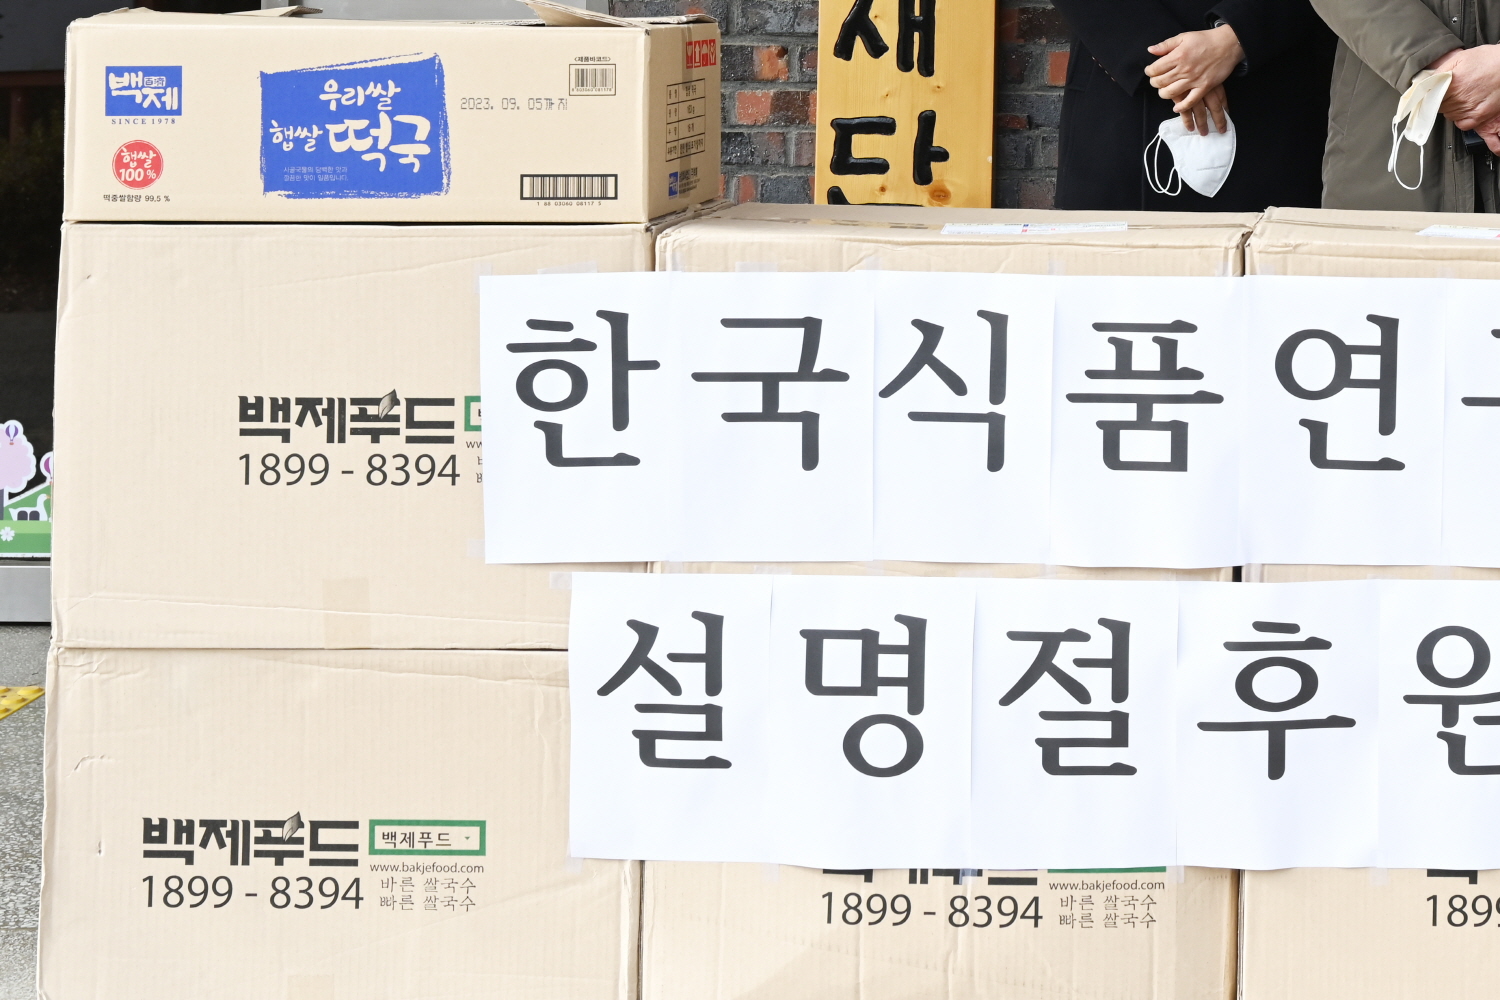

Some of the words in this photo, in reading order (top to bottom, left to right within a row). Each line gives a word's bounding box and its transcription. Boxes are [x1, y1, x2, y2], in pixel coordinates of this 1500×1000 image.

[108, 71, 178, 110] 백제
[319, 79, 401, 111] 우리쌀
[460, 98, 494, 110] 2023.
[502, 98, 520, 110] 09.
[270, 120, 323, 152] 햅쌀
[325, 112, 431, 173] 떡국
[120, 146, 156, 168] 햅쌀
[238, 393, 455, 444] 백제푸드
[239, 452, 330, 486] 1899
[366, 453, 460, 486] 8394
[142, 815, 359, 867] 백제푸드
[382, 830, 452, 849] 백제푸드
[370, 862, 484, 876] www.bakjefood.com
[142, 875, 233, 908] 1899
[270, 876, 364, 910] 8394
[380, 877, 414, 893] 바른
[424, 877, 476, 894] 쌀국수
[1049, 879, 1166, 892] www.bakjefood.com
[379, 895, 414, 912] 빠른
[424, 895, 476, 912] 쌀국수
[821, 892, 912, 926] 1899
[948, 895, 1043, 929] 8394
[1060, 894, 1095, 911] 바른
[1103, 894, 1157, 911] 쌀국수
[1058, 912, 1095, 929] 빠른
[1103, 912, 1157, 930] 쌀국수
